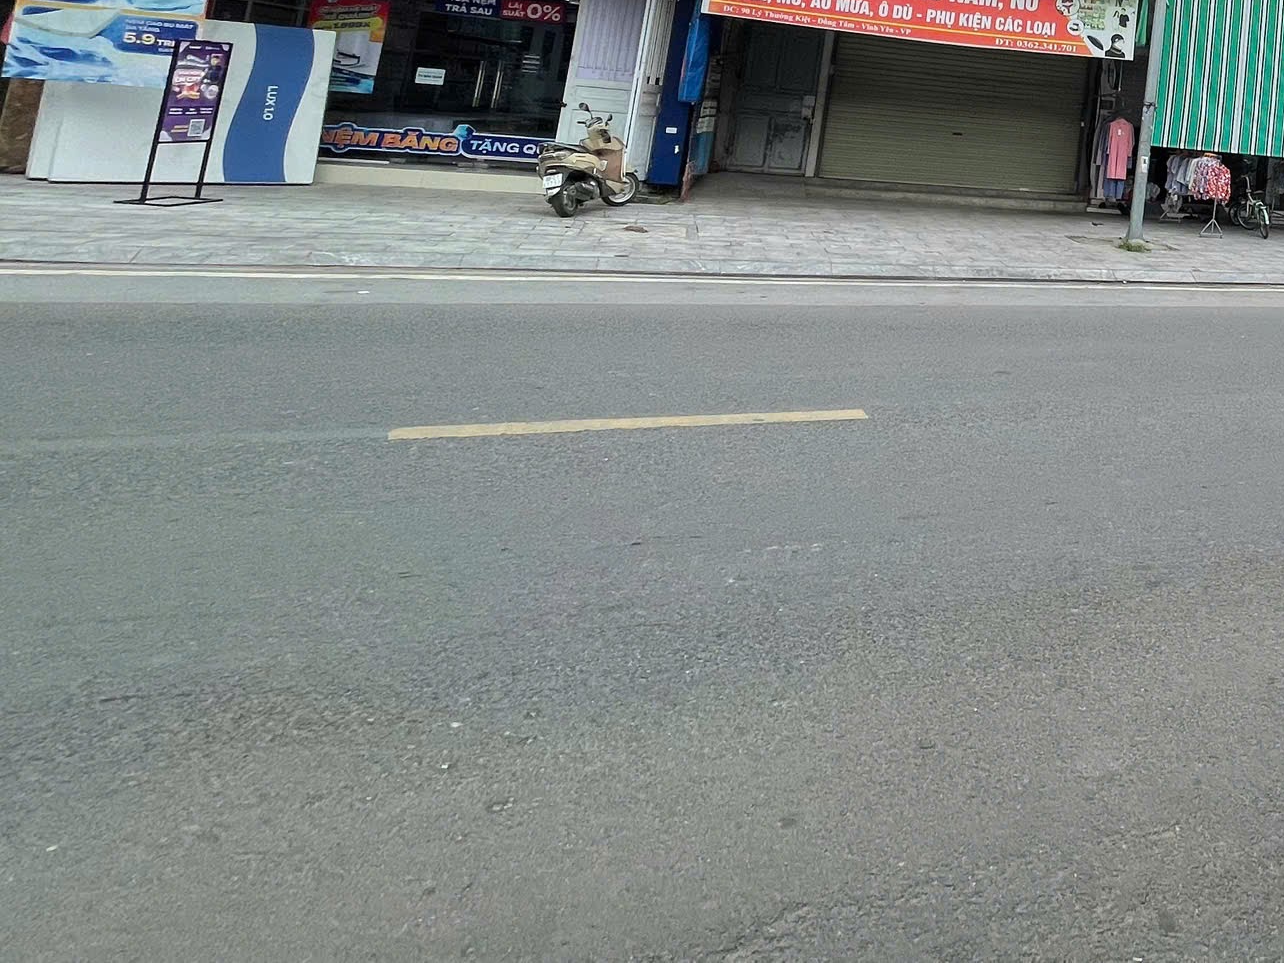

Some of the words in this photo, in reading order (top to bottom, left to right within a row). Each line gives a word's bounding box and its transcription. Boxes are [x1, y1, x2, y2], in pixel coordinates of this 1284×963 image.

[444, 3, 467, 14] TRẢ
[470, 5, 493, 16] SAU
[526, 3, 561, 22] 0%
[879, 1, 888, 18] Ô
[892, 2, 912, 21] DÙ
[926, 9, 956, 29] PHỤ
[958, 12, 992, 33] KIỆN
[995, 15, 1022, 34] CÁC
[1026, 20, 1056, 40] LOẠI
[123, 32, 156, 45] 5.9
[1016, 40, 1077, 53] 0362.341.701
[265, 85, 279, 105] LUX
[381, 130, 459, 152] BĂNG
[470, 138, 520, 154] TẶNG
